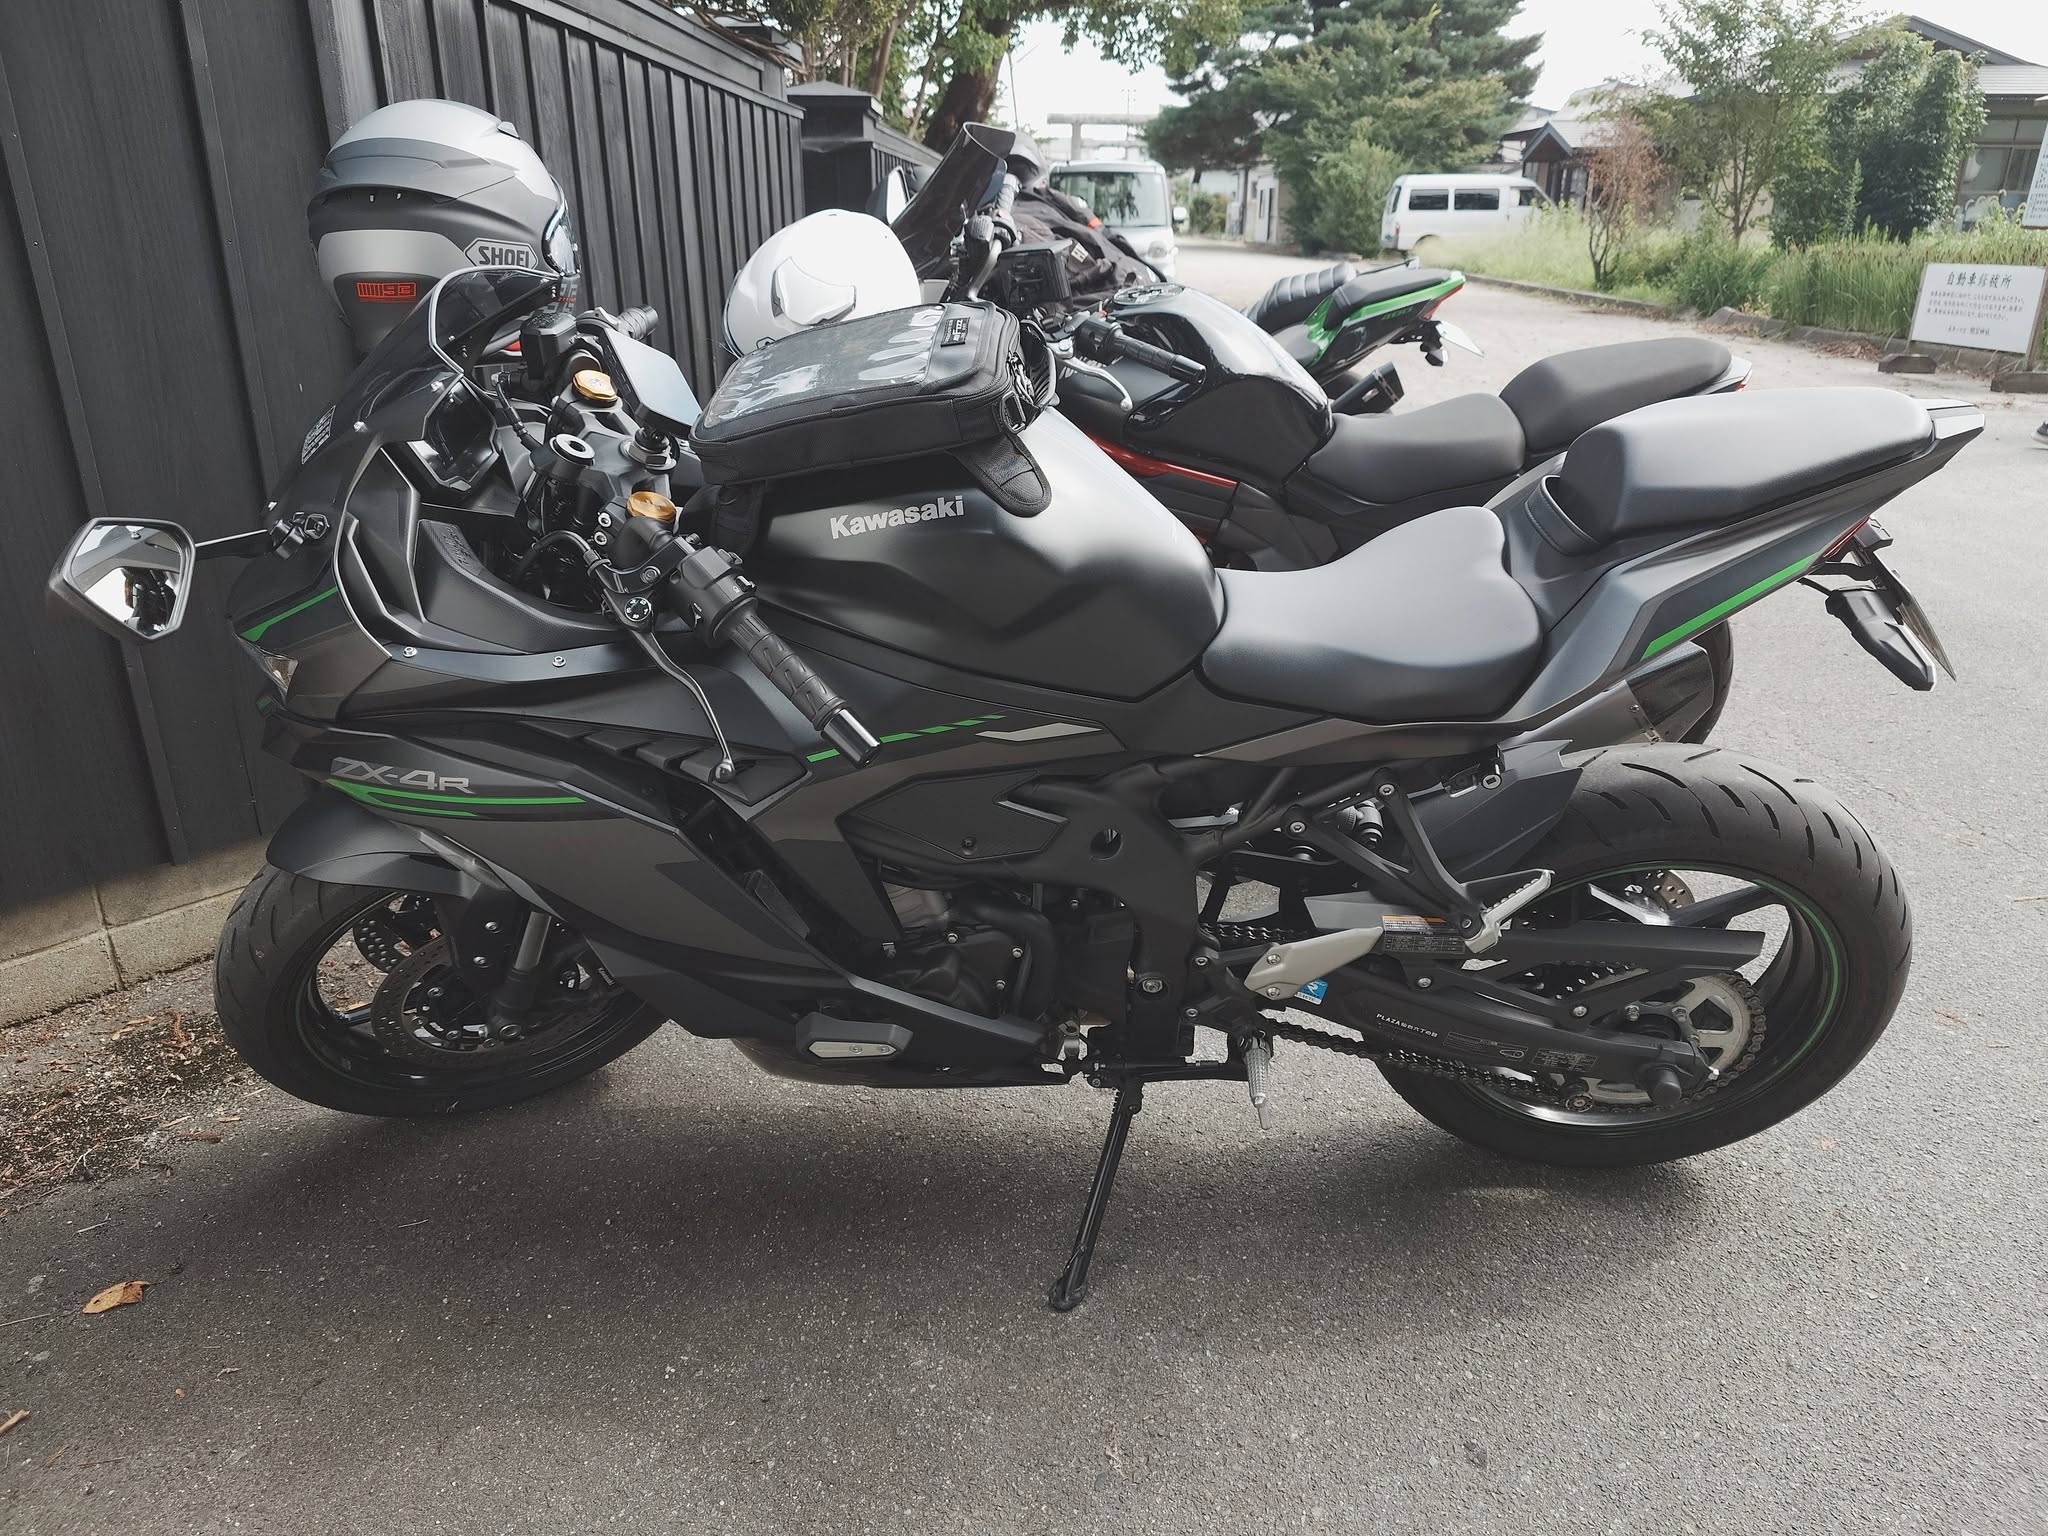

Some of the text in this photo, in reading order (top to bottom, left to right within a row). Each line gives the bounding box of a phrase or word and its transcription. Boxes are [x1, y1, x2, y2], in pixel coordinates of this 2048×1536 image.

[478, 245, 530, 268] SHOEI
[830, 495, 965, 540] Kawasaki
[330, 756, 475, 795] ZX-4R
